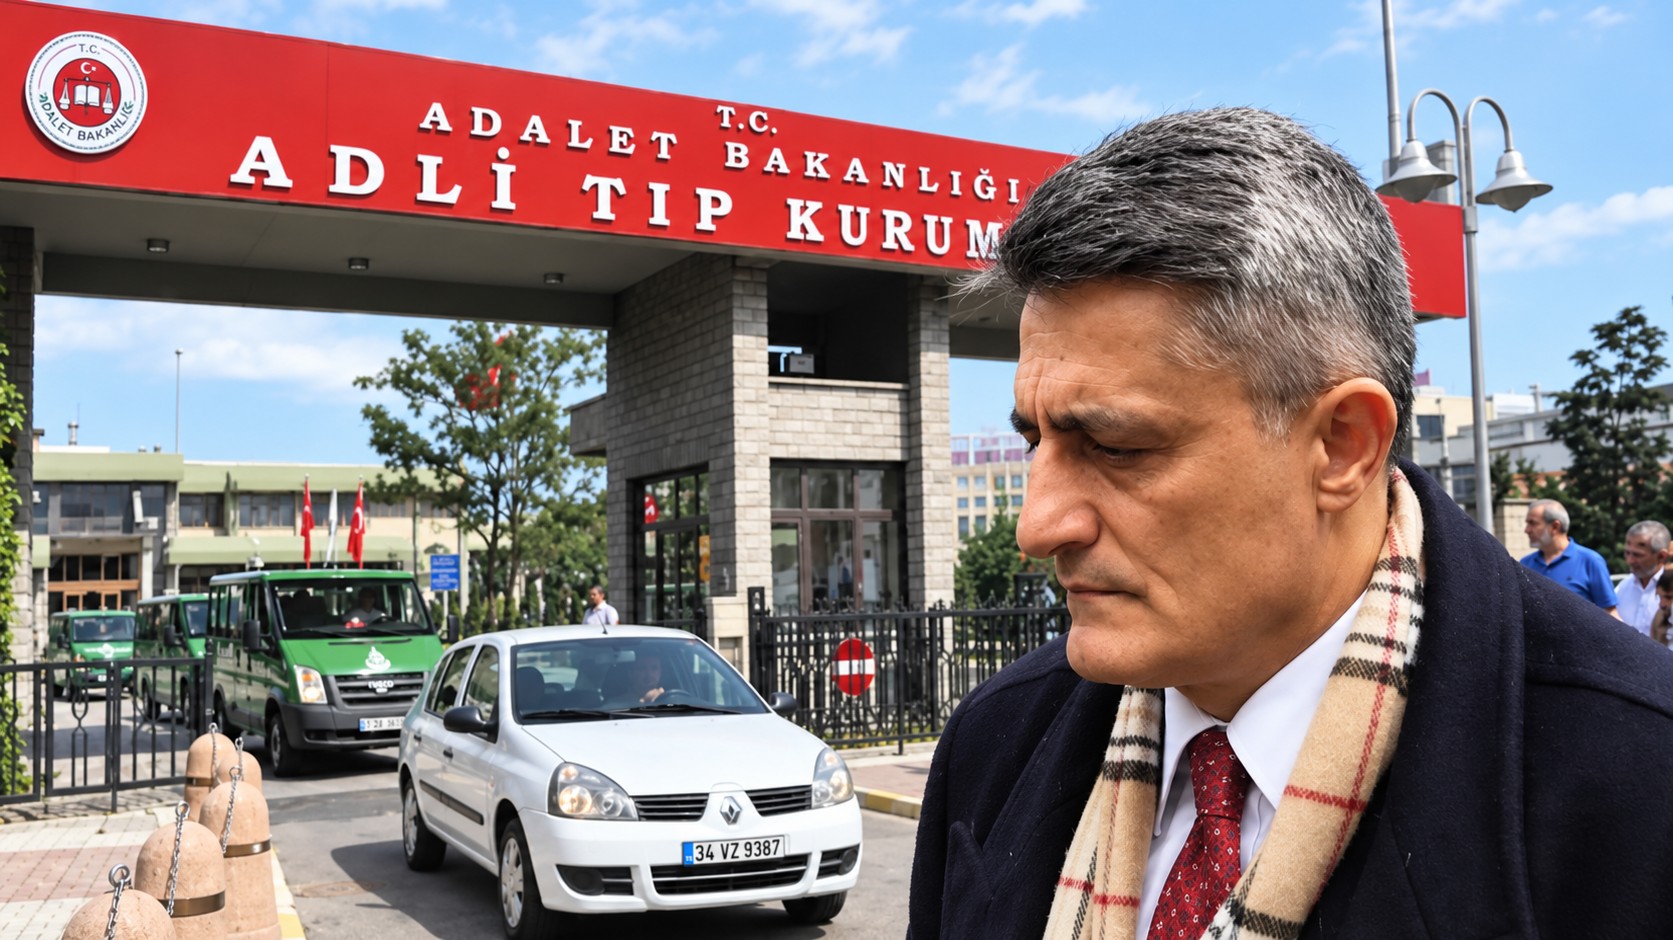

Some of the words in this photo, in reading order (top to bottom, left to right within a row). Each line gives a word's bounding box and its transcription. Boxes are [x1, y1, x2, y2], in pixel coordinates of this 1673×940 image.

[79, 43, 100, 55] T.C.
[716, 104, 778, 134] T.C.
[420, 102, 678, 160] ADALET
[725, 142, 1020, 204] BAKANLIĞI
[230, 136, 517, 210] ADLİ
[582, 174, 732, 231] TIP
[695, 844, 714, 862] 34
[720, 842, 740, 860] VZ
[744, 839, 780, 858] 9387
